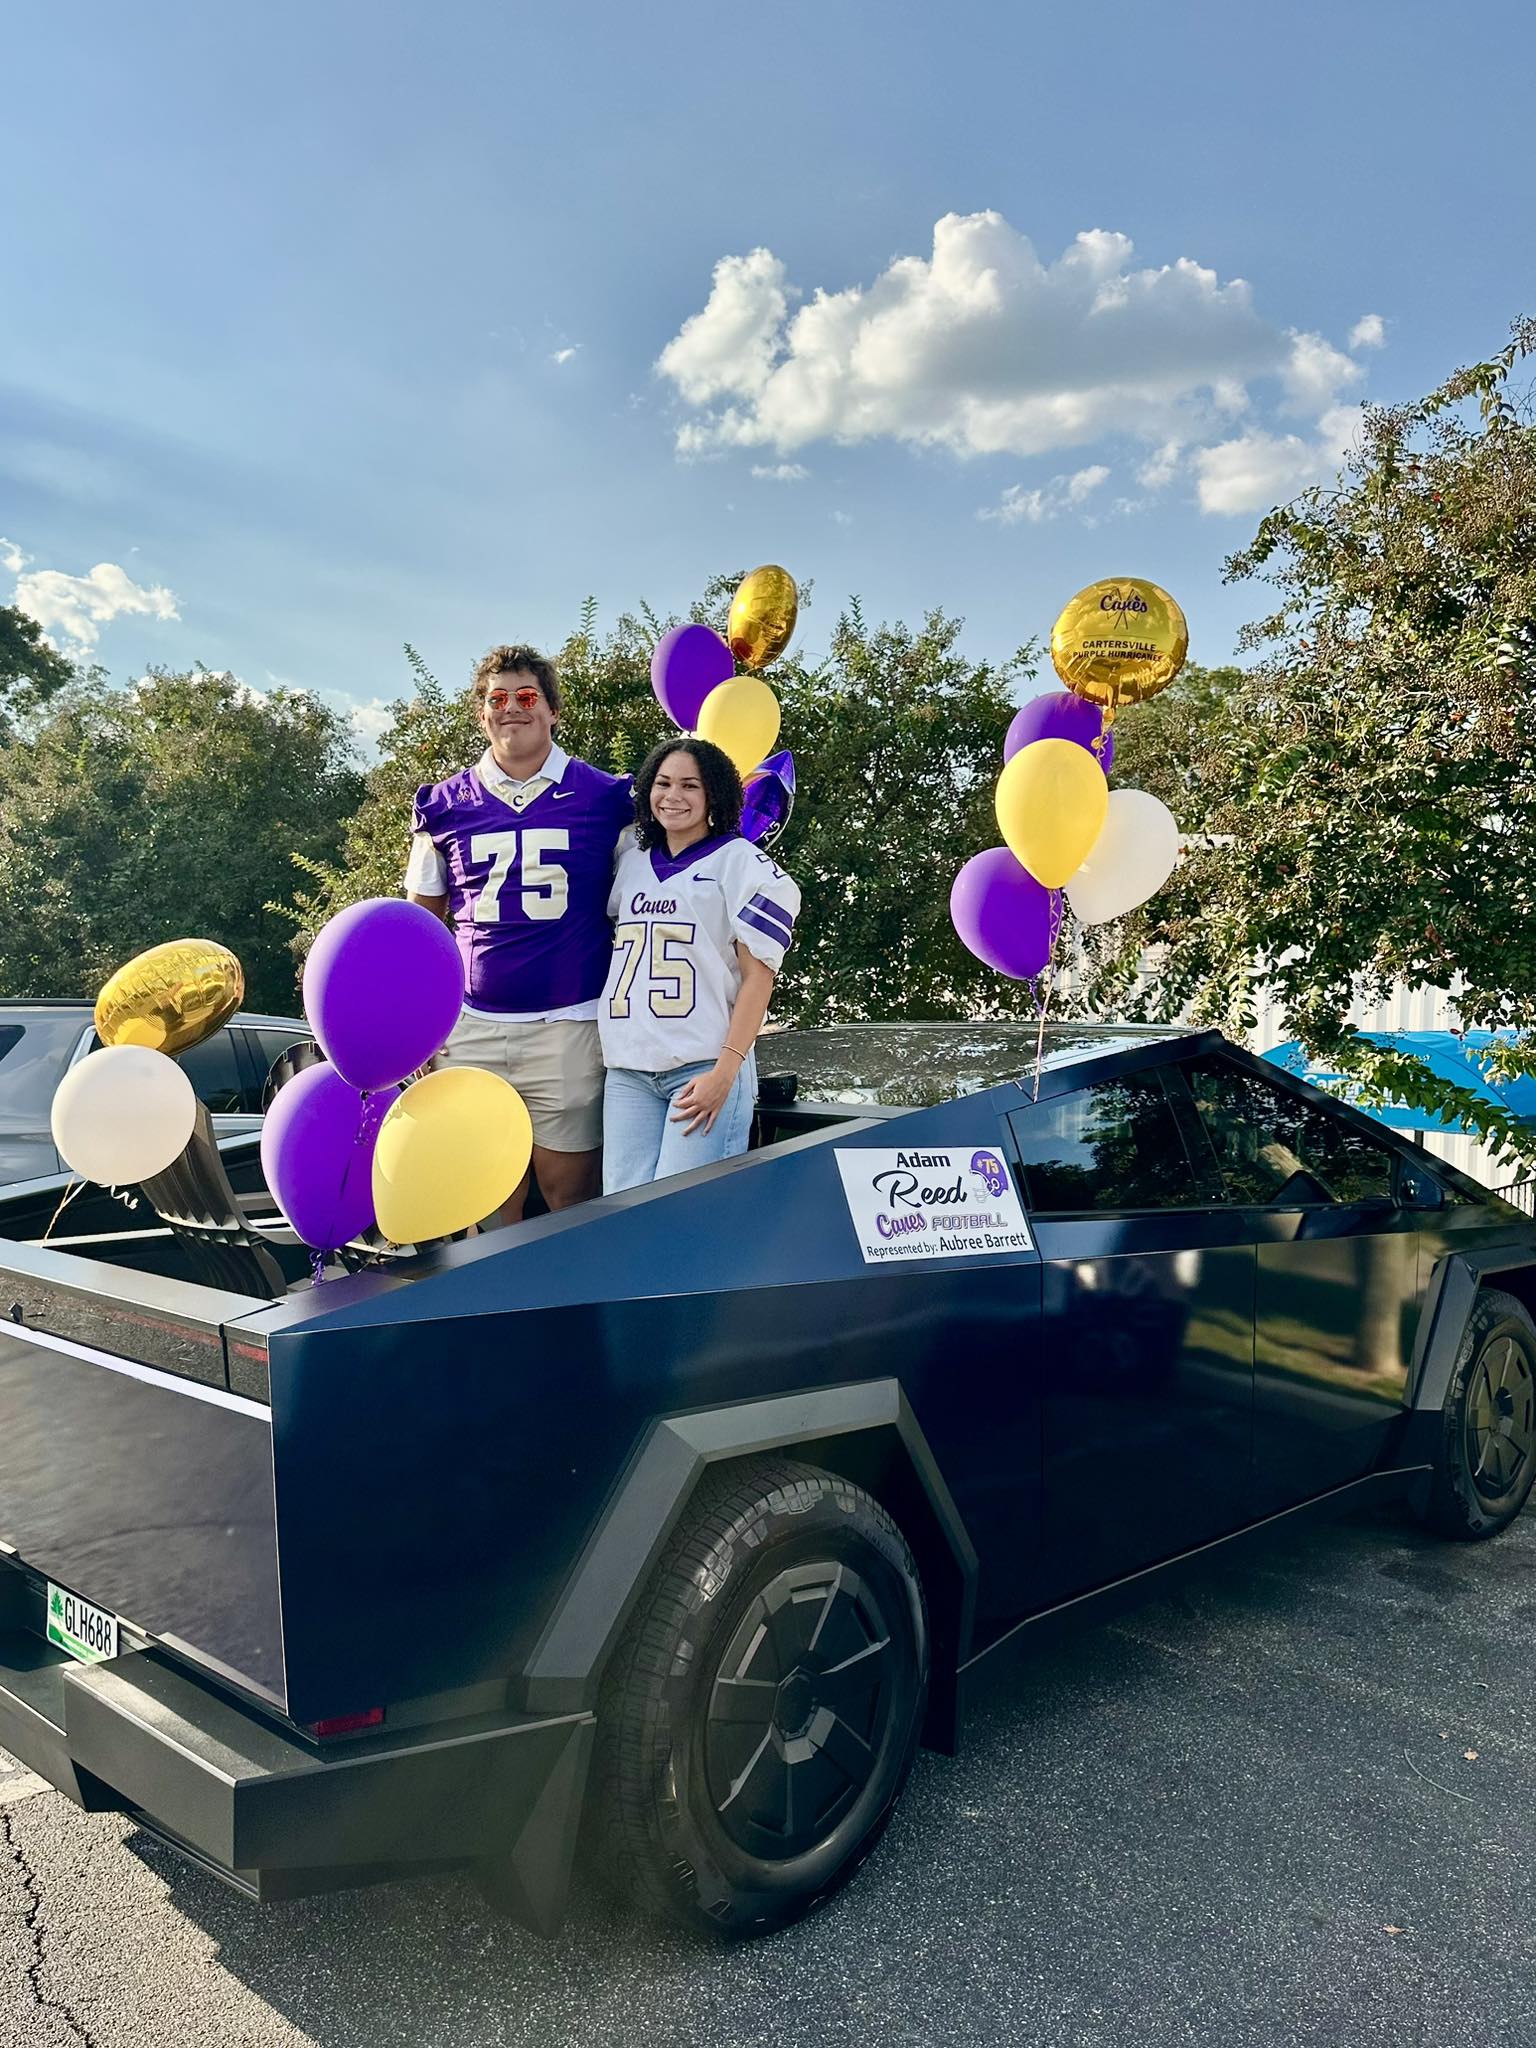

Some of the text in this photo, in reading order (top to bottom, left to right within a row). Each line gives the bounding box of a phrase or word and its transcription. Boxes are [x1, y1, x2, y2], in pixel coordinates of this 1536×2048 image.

[1100, 594, 1148, 613] Canes
[1072, 650, 1163, 662] PURPLE HURRICANES
[1082, 640, 1157, 652] CARTERSVILLE
[513, 795, 525, 807] C
[470, 828, 570, 923] 75
[630, 892, 677, 915] Canes
[609, 921, 696, 1019] 75
[897, 1152, 951, 1168] Adam
[976, 1158, 1000, 1175] #75
[872, 1170, 968, 1208] Reed
[876, 1211, 1008, 1240] Canes FOOTBALL
[867, 1232, 1028, 1259] Represented by: Aubree Barrett
[64, 1597, 112, 1657] GLH688
